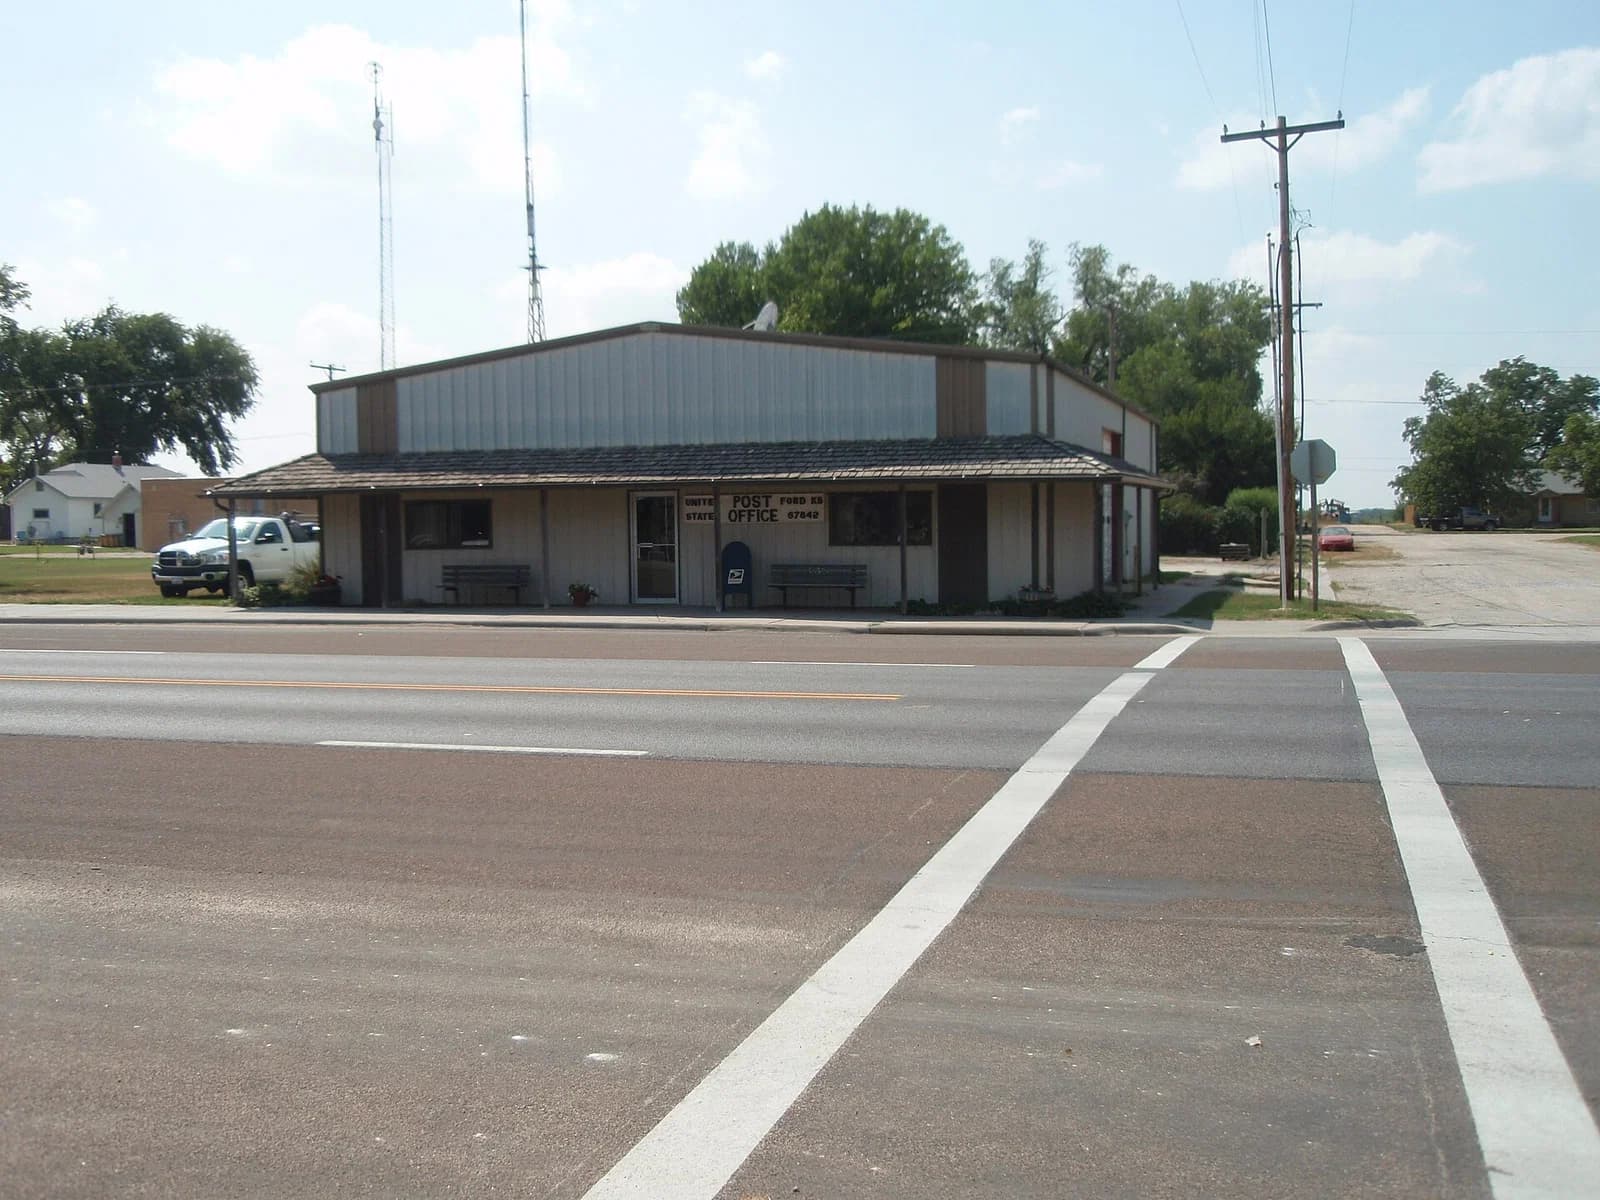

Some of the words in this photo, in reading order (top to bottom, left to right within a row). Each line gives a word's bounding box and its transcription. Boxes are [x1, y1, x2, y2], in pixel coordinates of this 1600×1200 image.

[685, 498, 715, 506] UNITE
[732, 495, 772, 508] POST
[780, 496, 806, 505] FORD
[811, 496, 823, 505] KS
[686, 512, 716, 520] STATE
[728, 509, 779, 522] OFFICE
[787, 511, 819, 519] 67842
